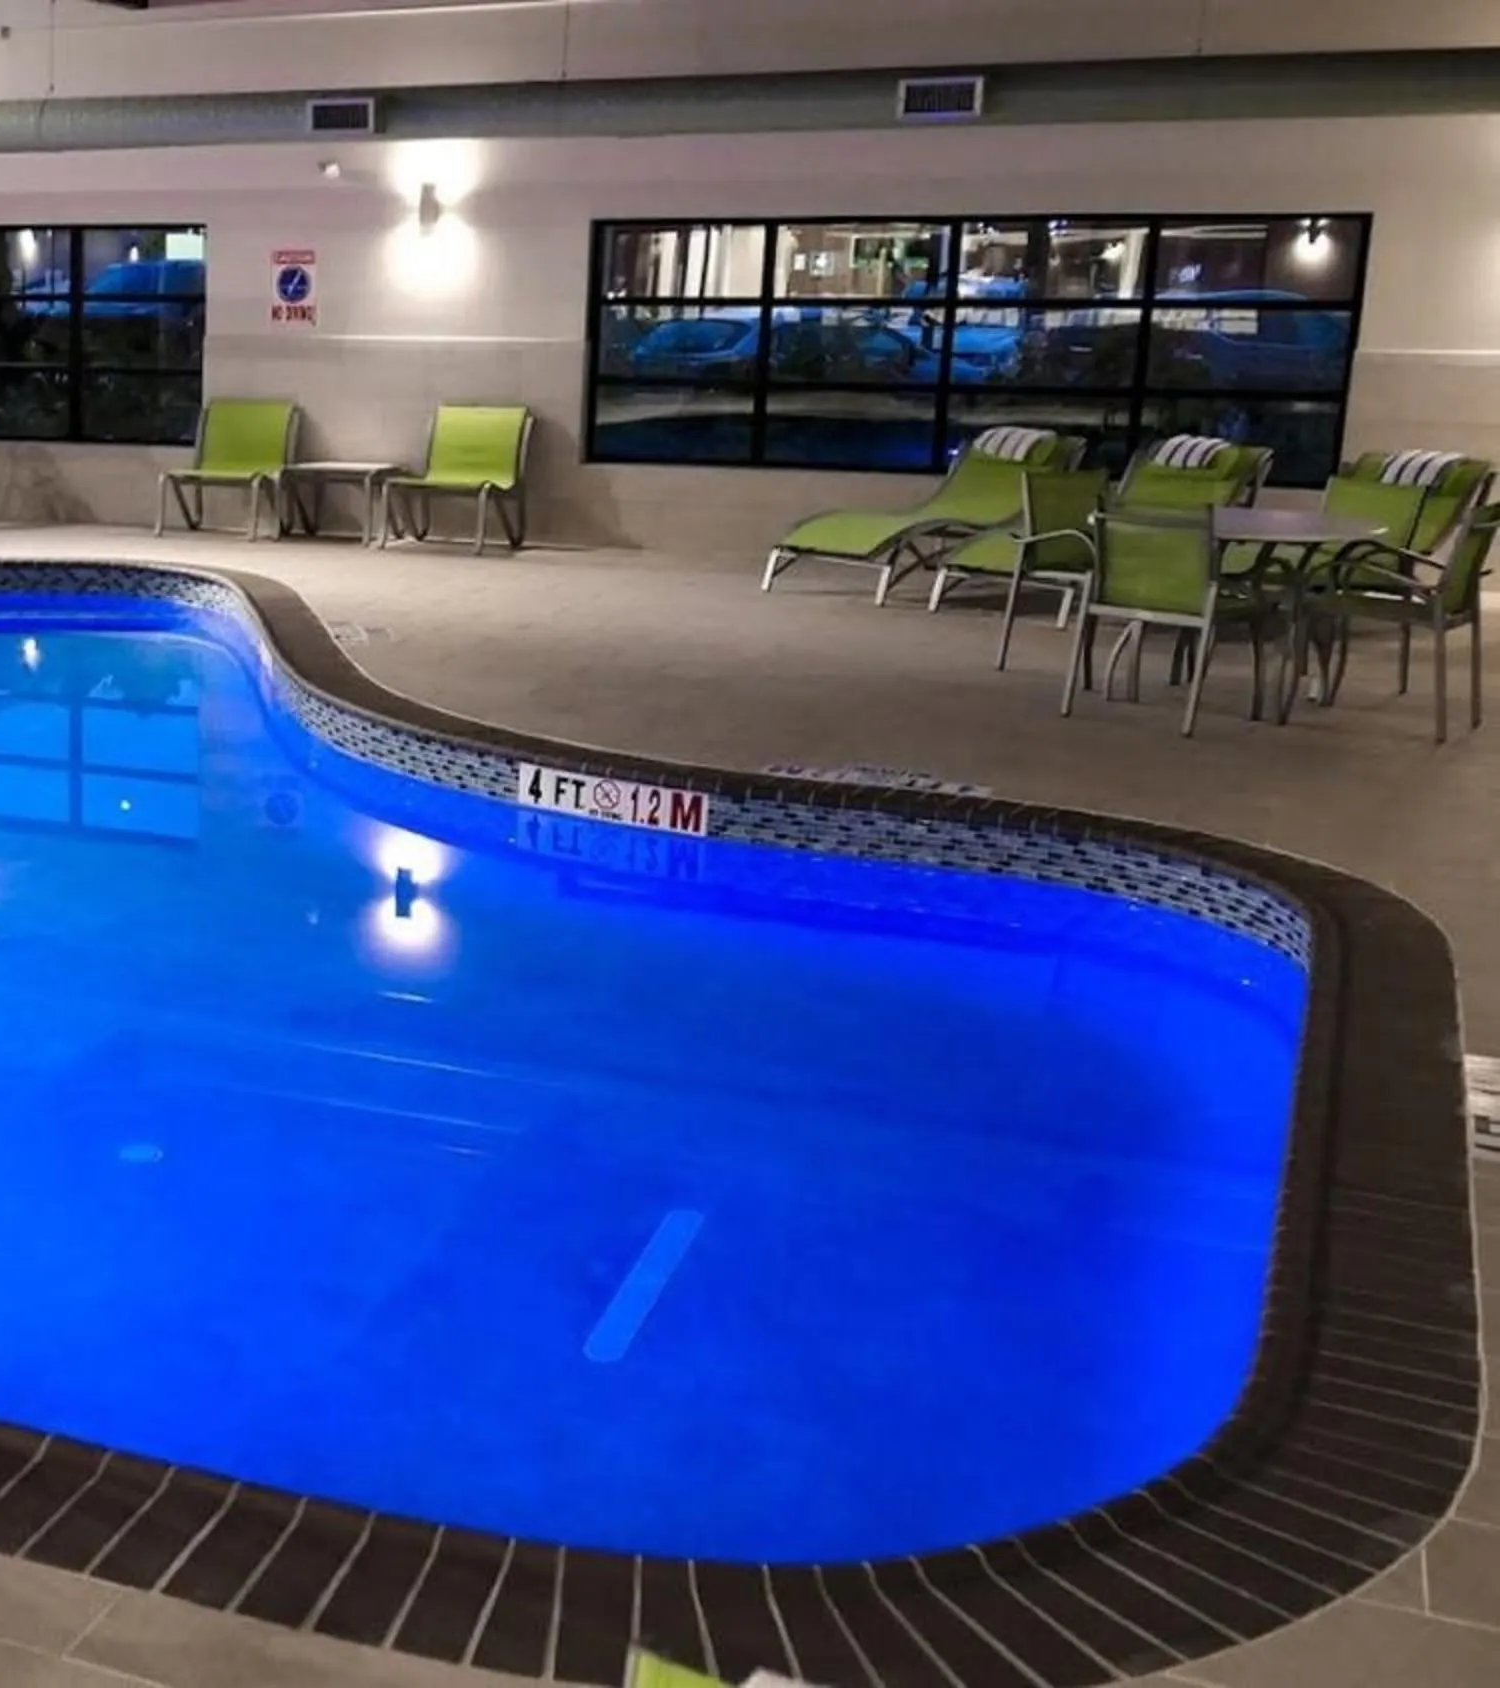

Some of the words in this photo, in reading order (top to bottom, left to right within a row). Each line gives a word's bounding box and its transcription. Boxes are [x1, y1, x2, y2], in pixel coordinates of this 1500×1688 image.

[529, 768, 542, 804] 4
[632, 785, 661, 826] 1.2
[670, 793, 703, 832] M
